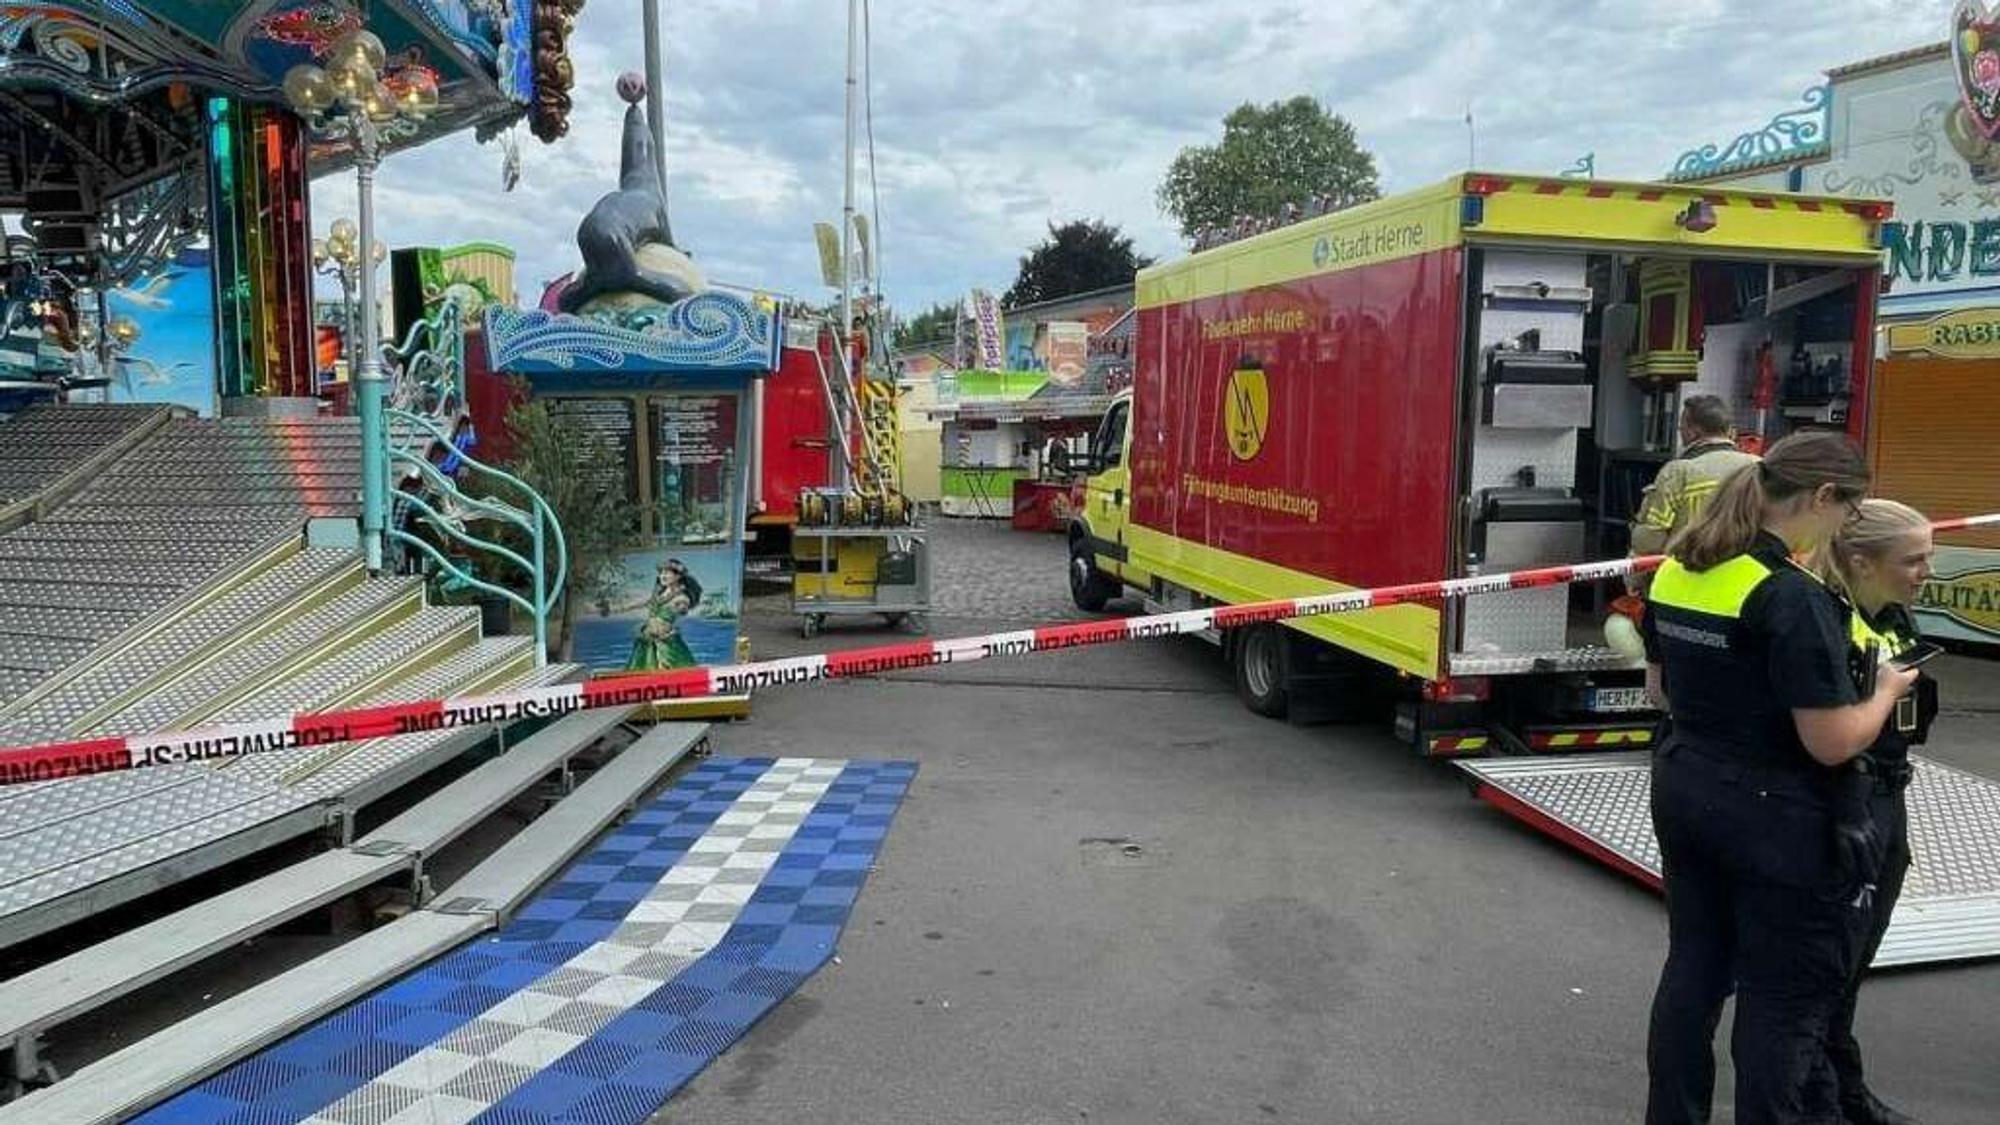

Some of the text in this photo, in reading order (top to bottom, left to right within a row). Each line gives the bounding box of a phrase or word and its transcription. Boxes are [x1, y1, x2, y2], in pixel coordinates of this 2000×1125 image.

[1330, 222, 1424, 263] Stadt Herne
[1203, 309, 1306, 340] Feuerwehr Herne
[1184, 473, 1319, 523] Führungsunterstützung
